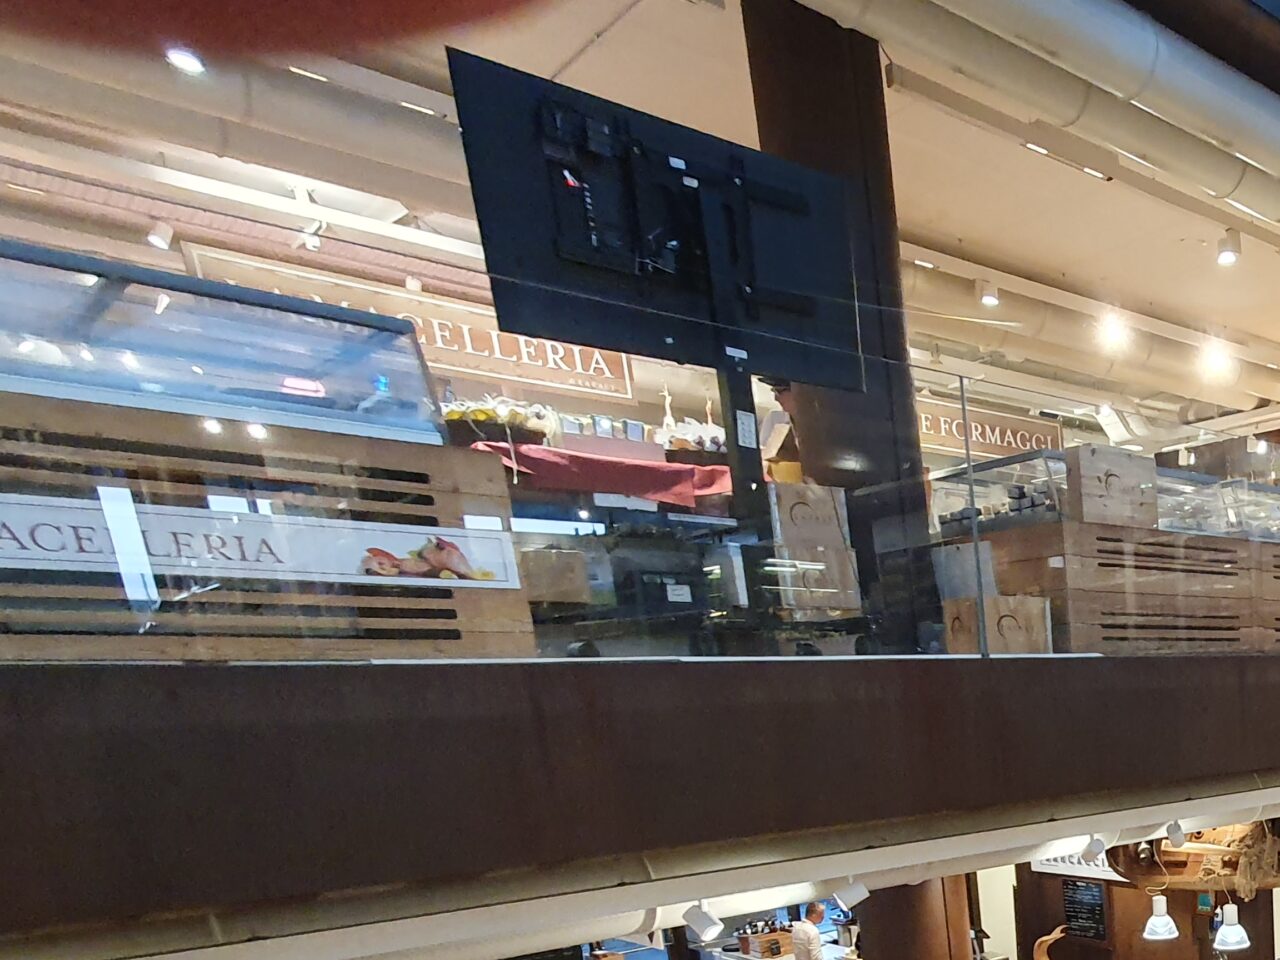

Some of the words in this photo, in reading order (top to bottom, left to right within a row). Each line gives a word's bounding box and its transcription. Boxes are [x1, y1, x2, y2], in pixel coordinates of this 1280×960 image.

[920, 413, 935, 435] E
[937, 416, 1054, 451] FORMAGGI
[0, 521, 285, 565] ACELERIA
